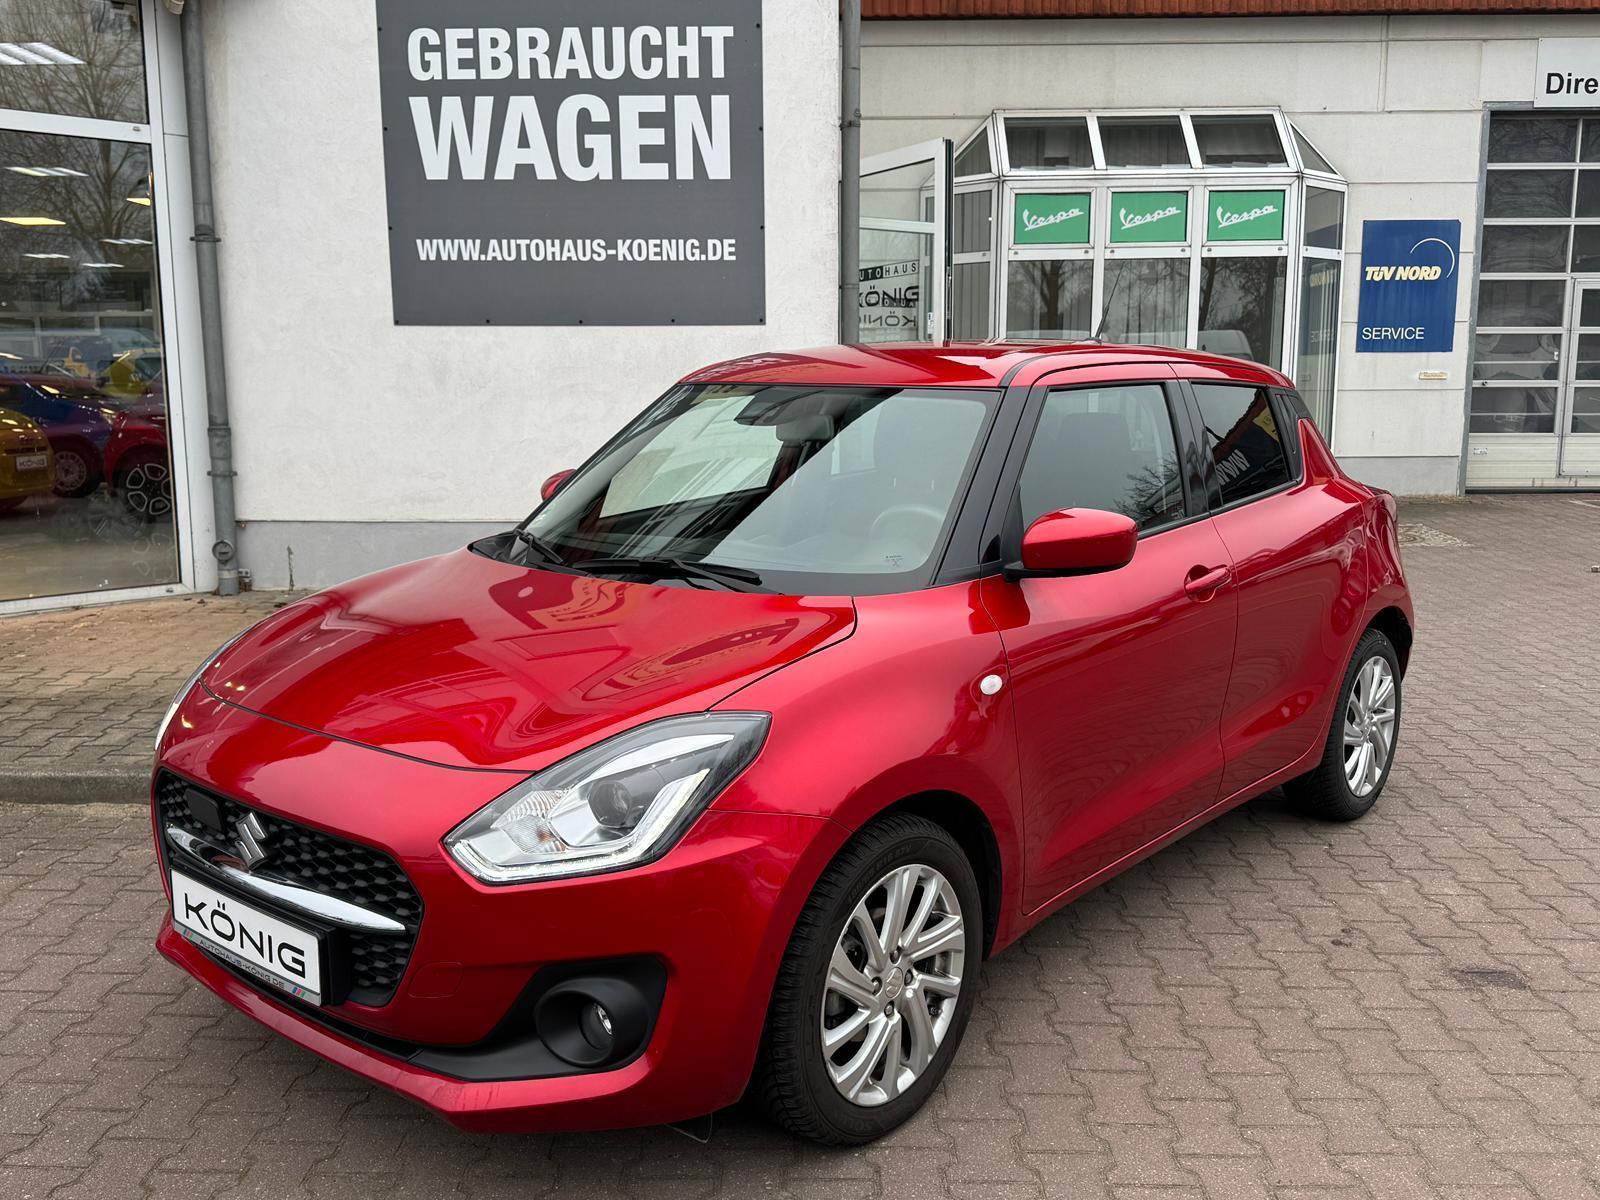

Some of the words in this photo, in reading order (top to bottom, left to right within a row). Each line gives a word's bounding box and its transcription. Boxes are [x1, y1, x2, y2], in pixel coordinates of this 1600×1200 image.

[407, 26, 735, 81] GEBRAUCHT
[1545, 72, 1599, 95] Dire
[408, 93, 732, 182] WAGEN
[1022, 208, 1085, 231] Vespa
[1119, 206, 1182, 230] Vespa
[1216, 204, 1279, 229] Vespa
[415, 238, 737, 262] WWW.AUTOHAUS-KOENIG.DE
[859, 262, 917, 280] UTOHAUS
[1365, 265, 1396, 281] TÜV
[1395, 265, 1442, 281] NORD
[1361, 326, 1425, 340] SERVICE
[184, 893, 306, 979] KÖNIG
